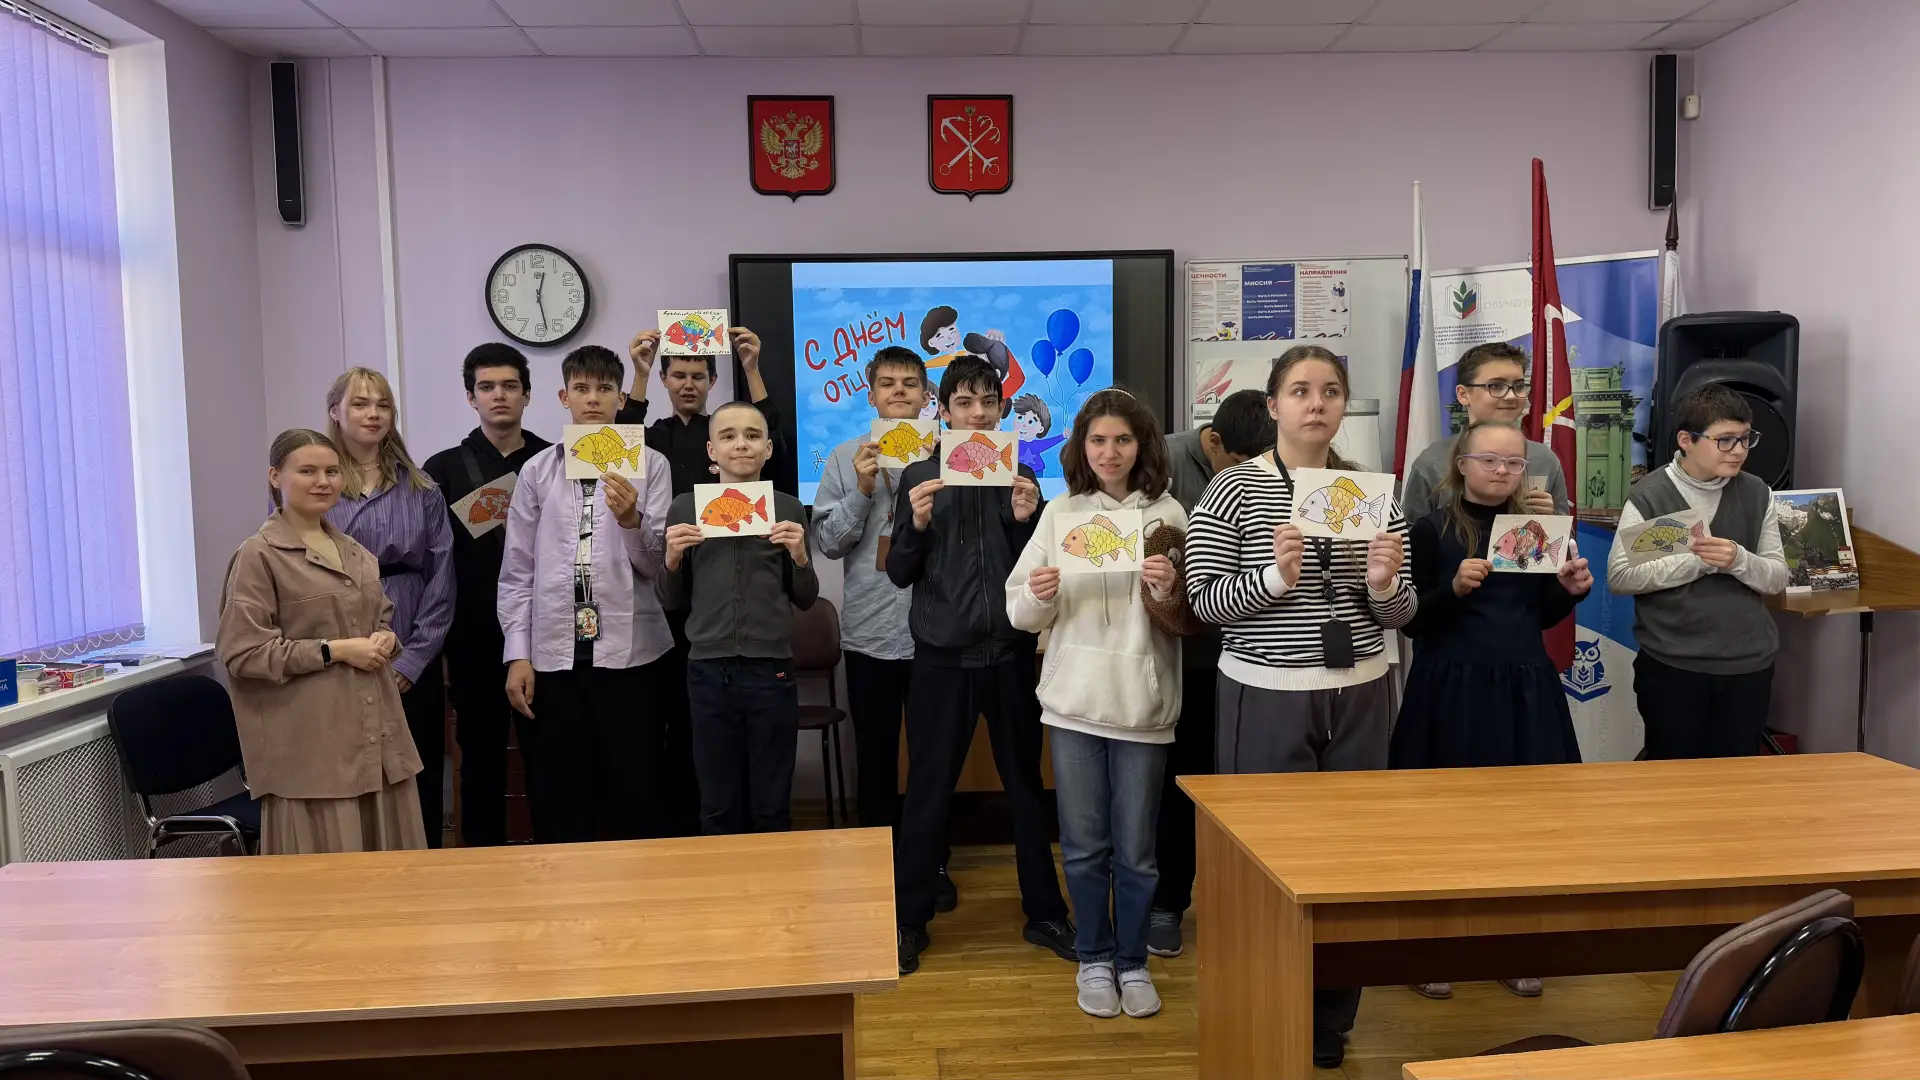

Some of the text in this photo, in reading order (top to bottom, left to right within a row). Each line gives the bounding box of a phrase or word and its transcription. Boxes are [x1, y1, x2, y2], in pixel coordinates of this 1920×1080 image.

[515, 260, 526, 274] 11
[529, 254, 545, 269] 12
[552, 259, 558, 274] 1
[502, 273, 517, 287] 10
[562, 271, 574, 287] 2
[497, 288, 510, 303] 9
[568, 288, 581, 303] 3
[504, 305, 517, 321] 8
[563, 306, 577, 321] 4
[516, 317, 530, 333] 7
[534, 322, 548, 338] 6
[551, 318, 564, 333] 5
[823, 365, 872, 403] ОТЦ
